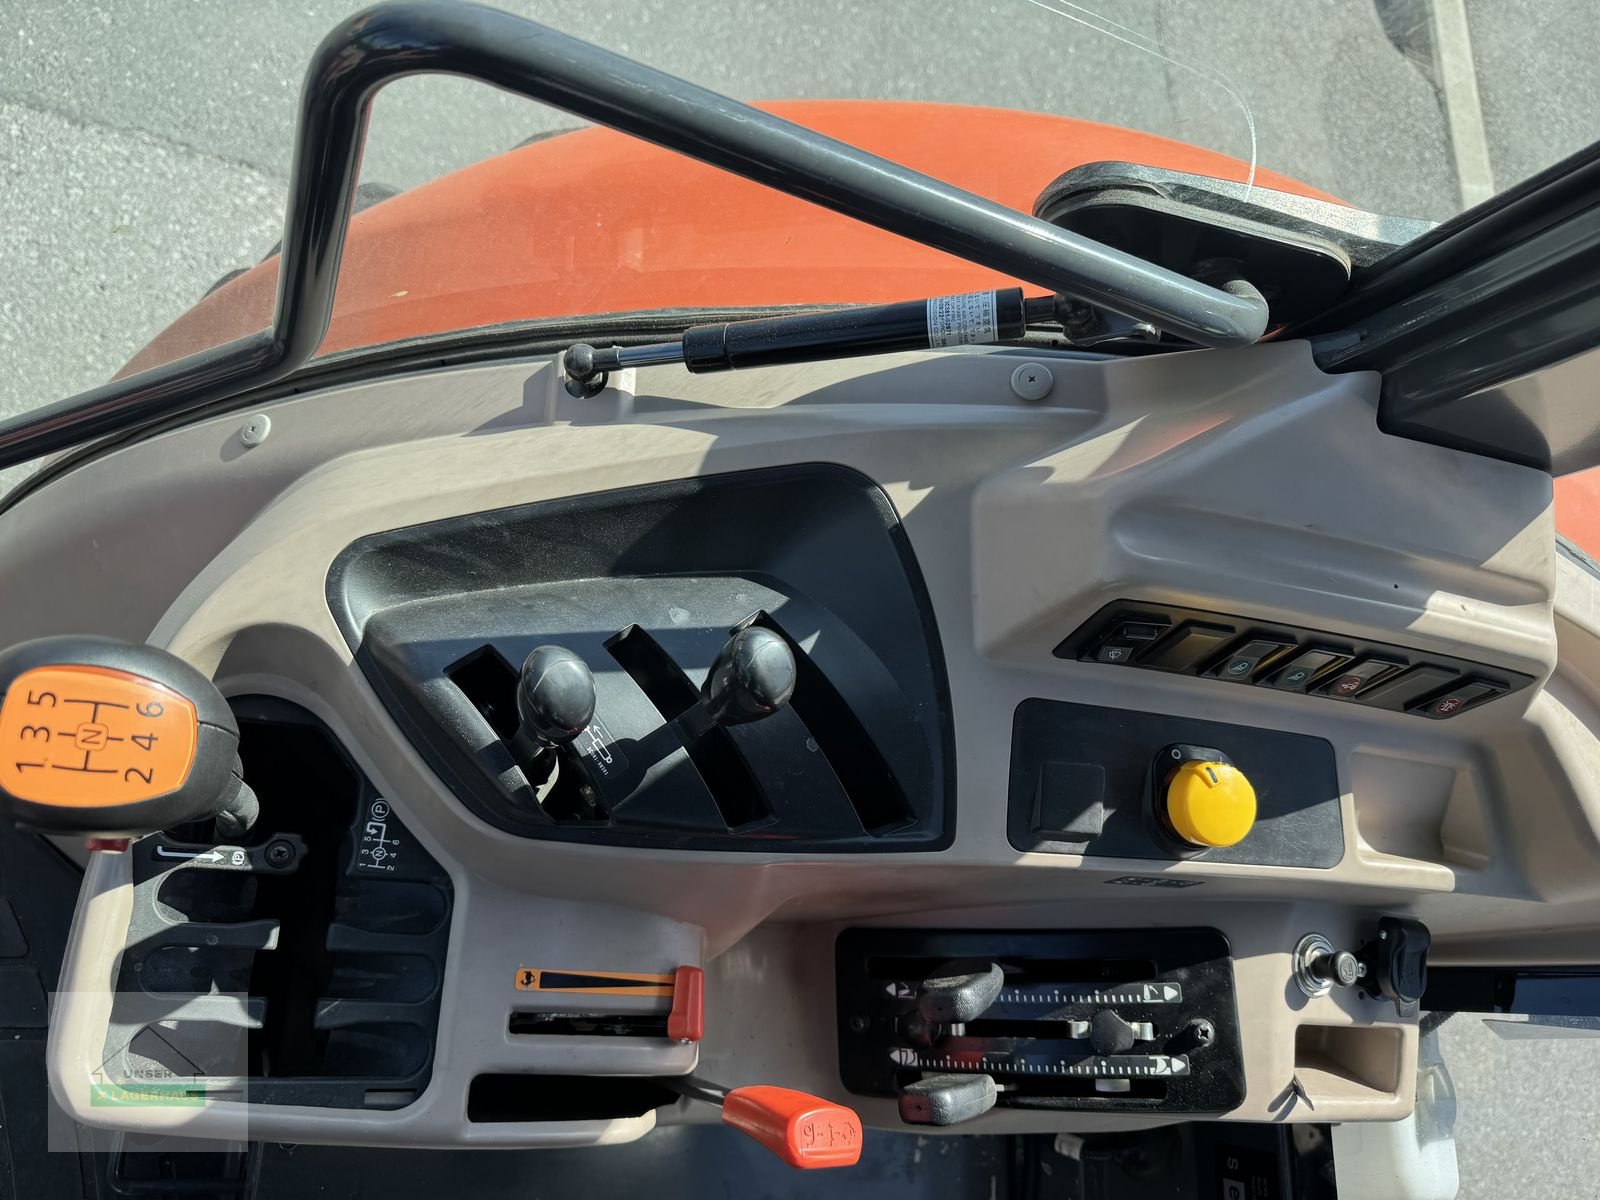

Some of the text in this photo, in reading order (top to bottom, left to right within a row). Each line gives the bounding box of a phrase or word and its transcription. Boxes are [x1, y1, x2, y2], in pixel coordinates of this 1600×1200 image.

[16, 690, 56, 773] 1 3 5
[81, 729, 102, 744] N
[124, 701, 164, 784] 2 4 6
